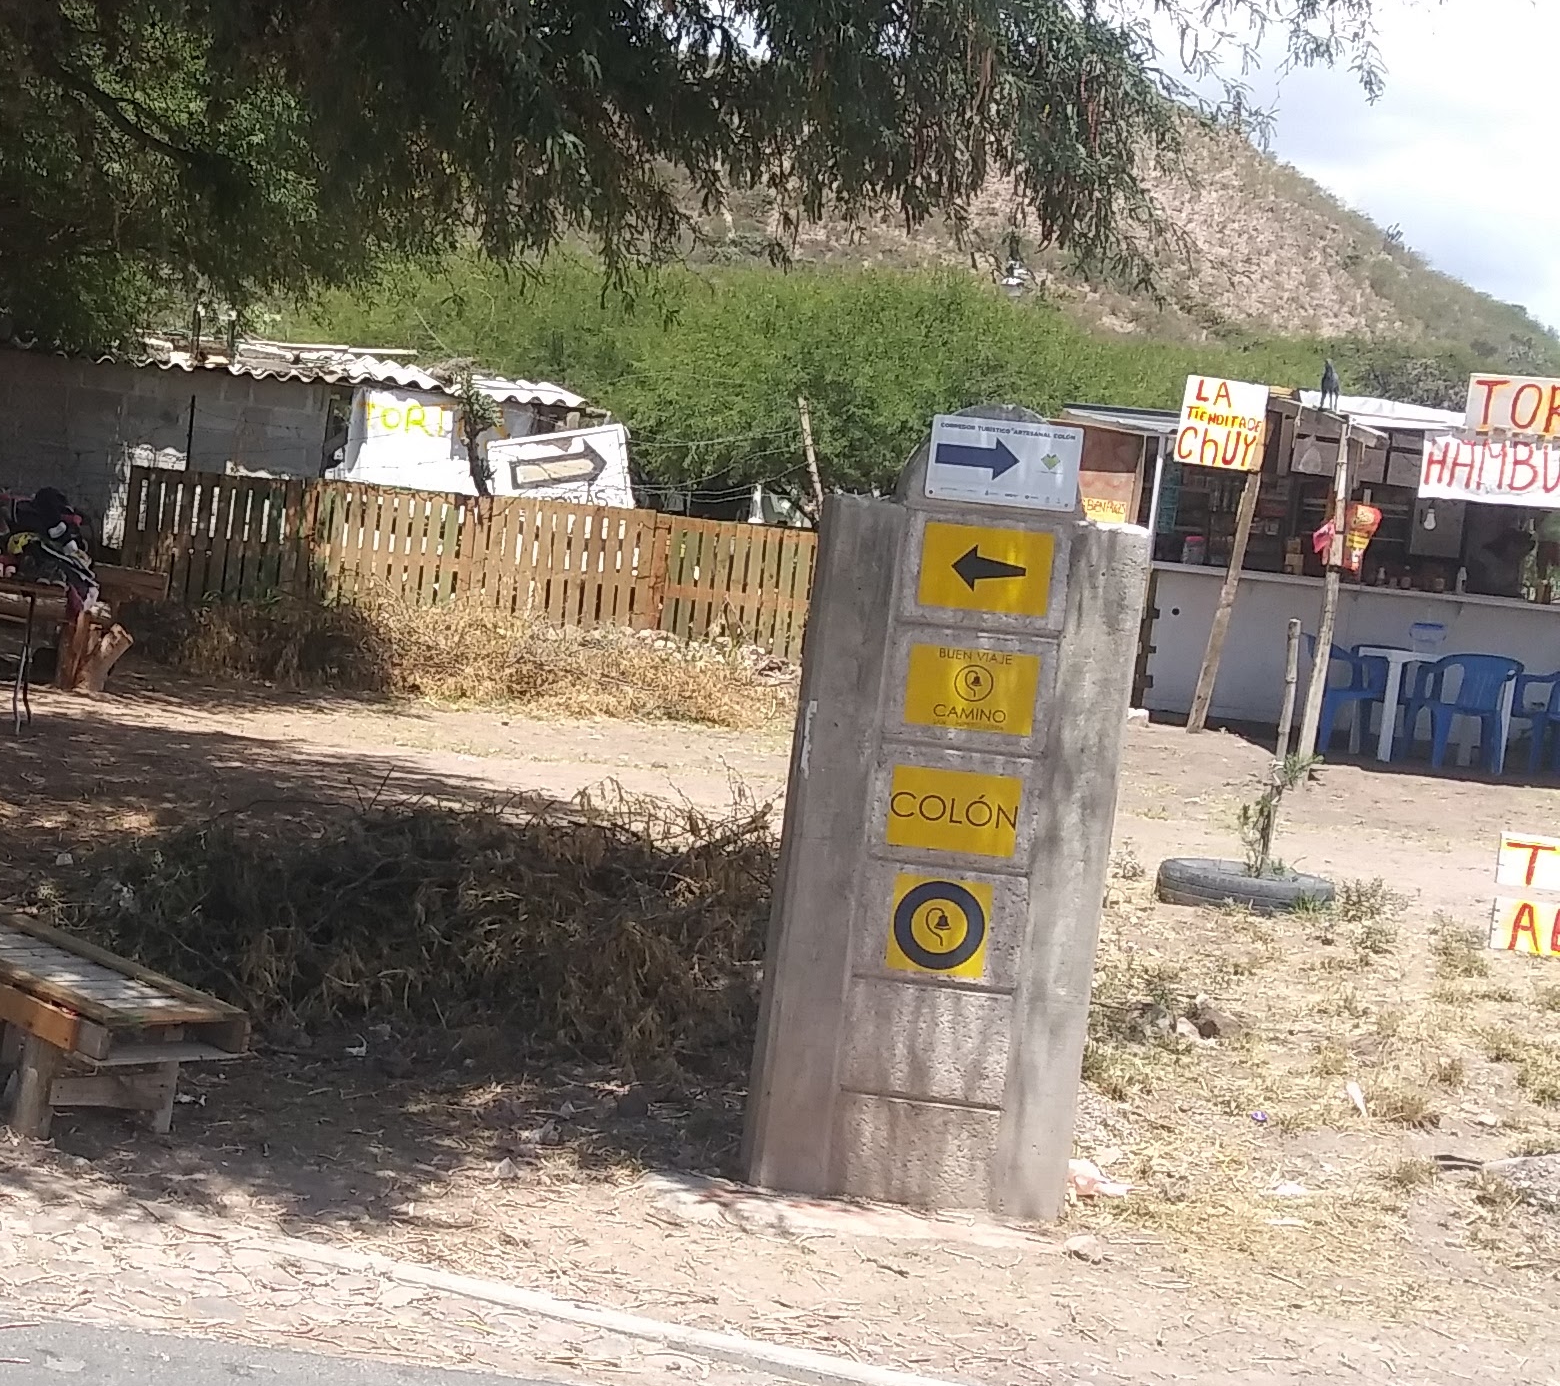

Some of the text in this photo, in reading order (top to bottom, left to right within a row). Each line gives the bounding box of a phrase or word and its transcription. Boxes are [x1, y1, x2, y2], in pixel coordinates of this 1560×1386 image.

[1195, 378, 1232, 408] LA
[940, 422, 976, 431] CORREDOR
[939, 647, 1014, 666] BUEN VIAJE
[933, 703, 1007, 724] CAMINO
[890, 791, 1019, 832] COLÓN
